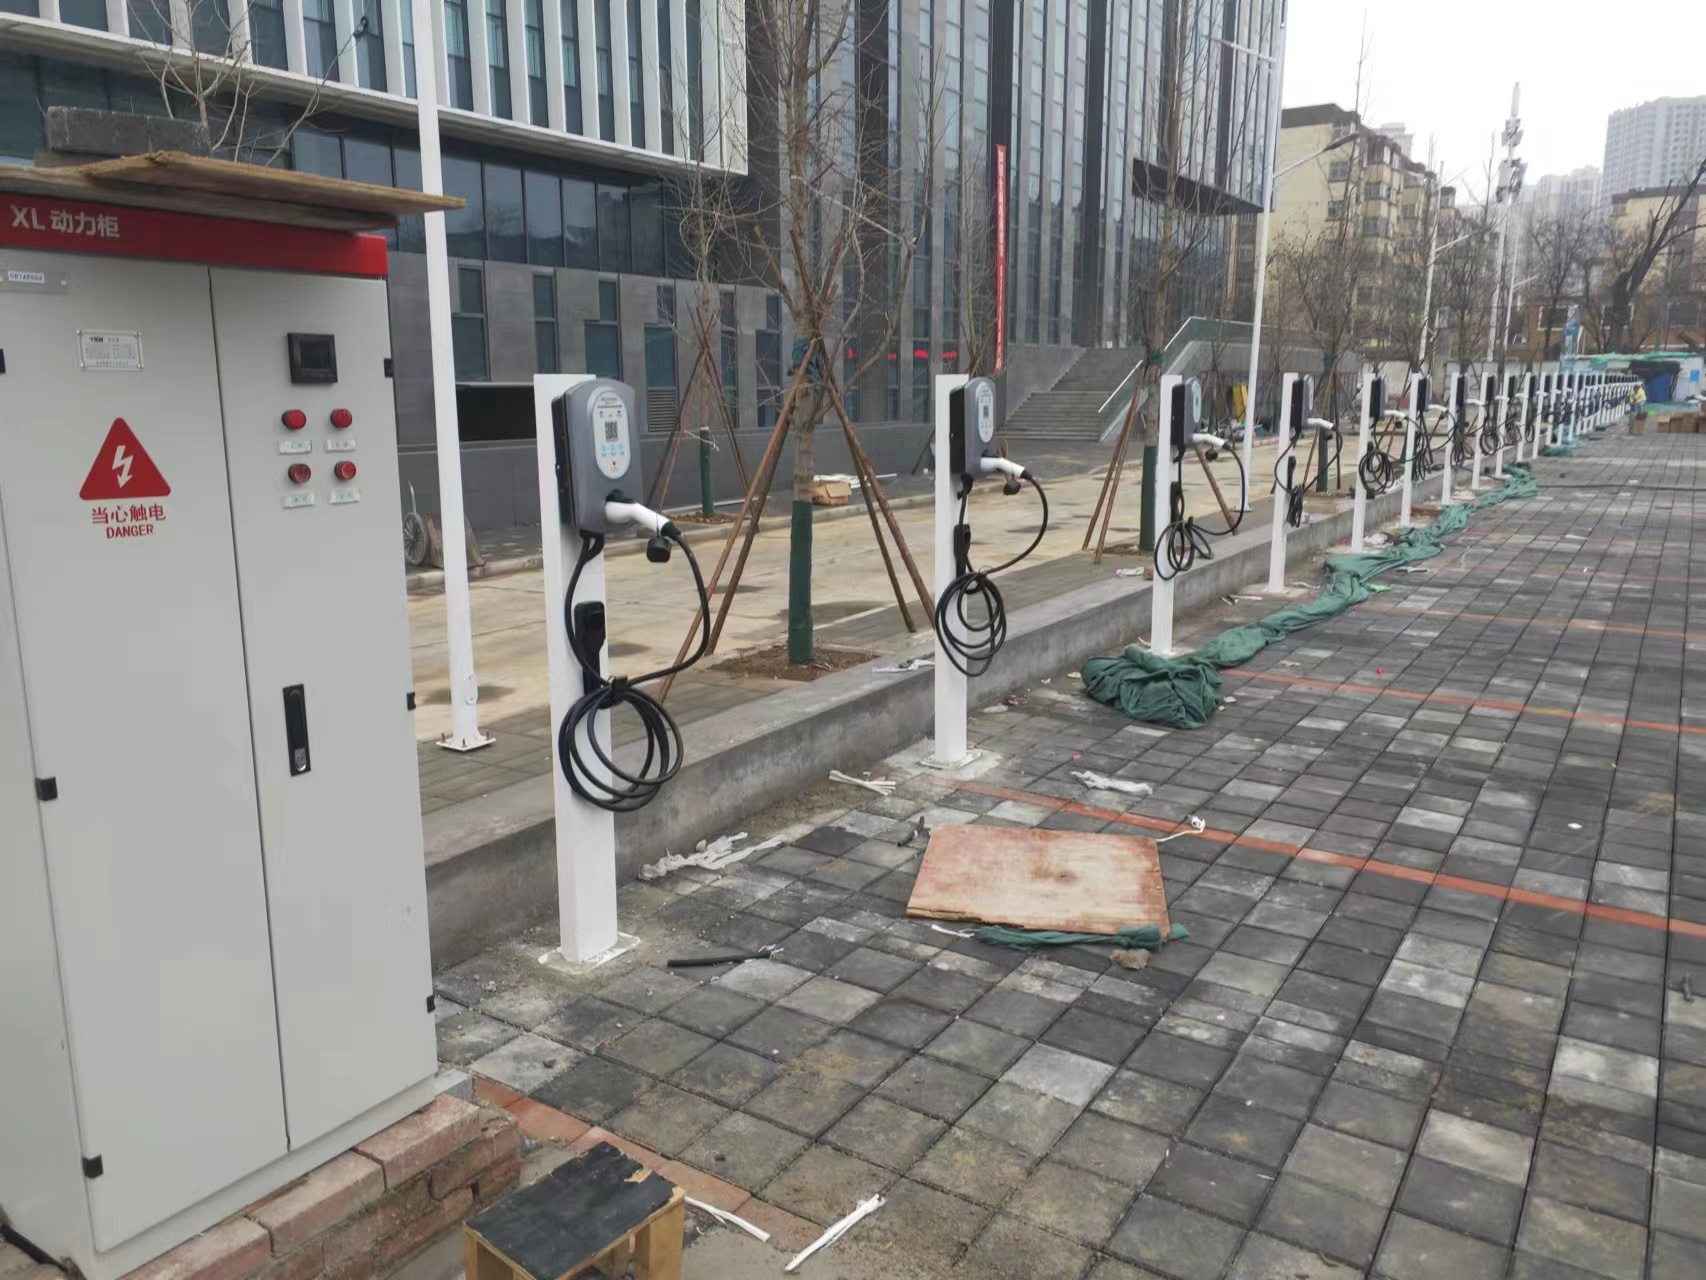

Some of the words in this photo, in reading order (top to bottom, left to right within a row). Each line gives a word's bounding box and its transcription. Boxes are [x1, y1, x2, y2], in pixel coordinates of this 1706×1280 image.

[10, 204, 45, 231] XL
[50, 209, 120, 237] 动力柜
[92, 503, 166, 524] 当心触电
[106, 524, 153, 538] DANGER
